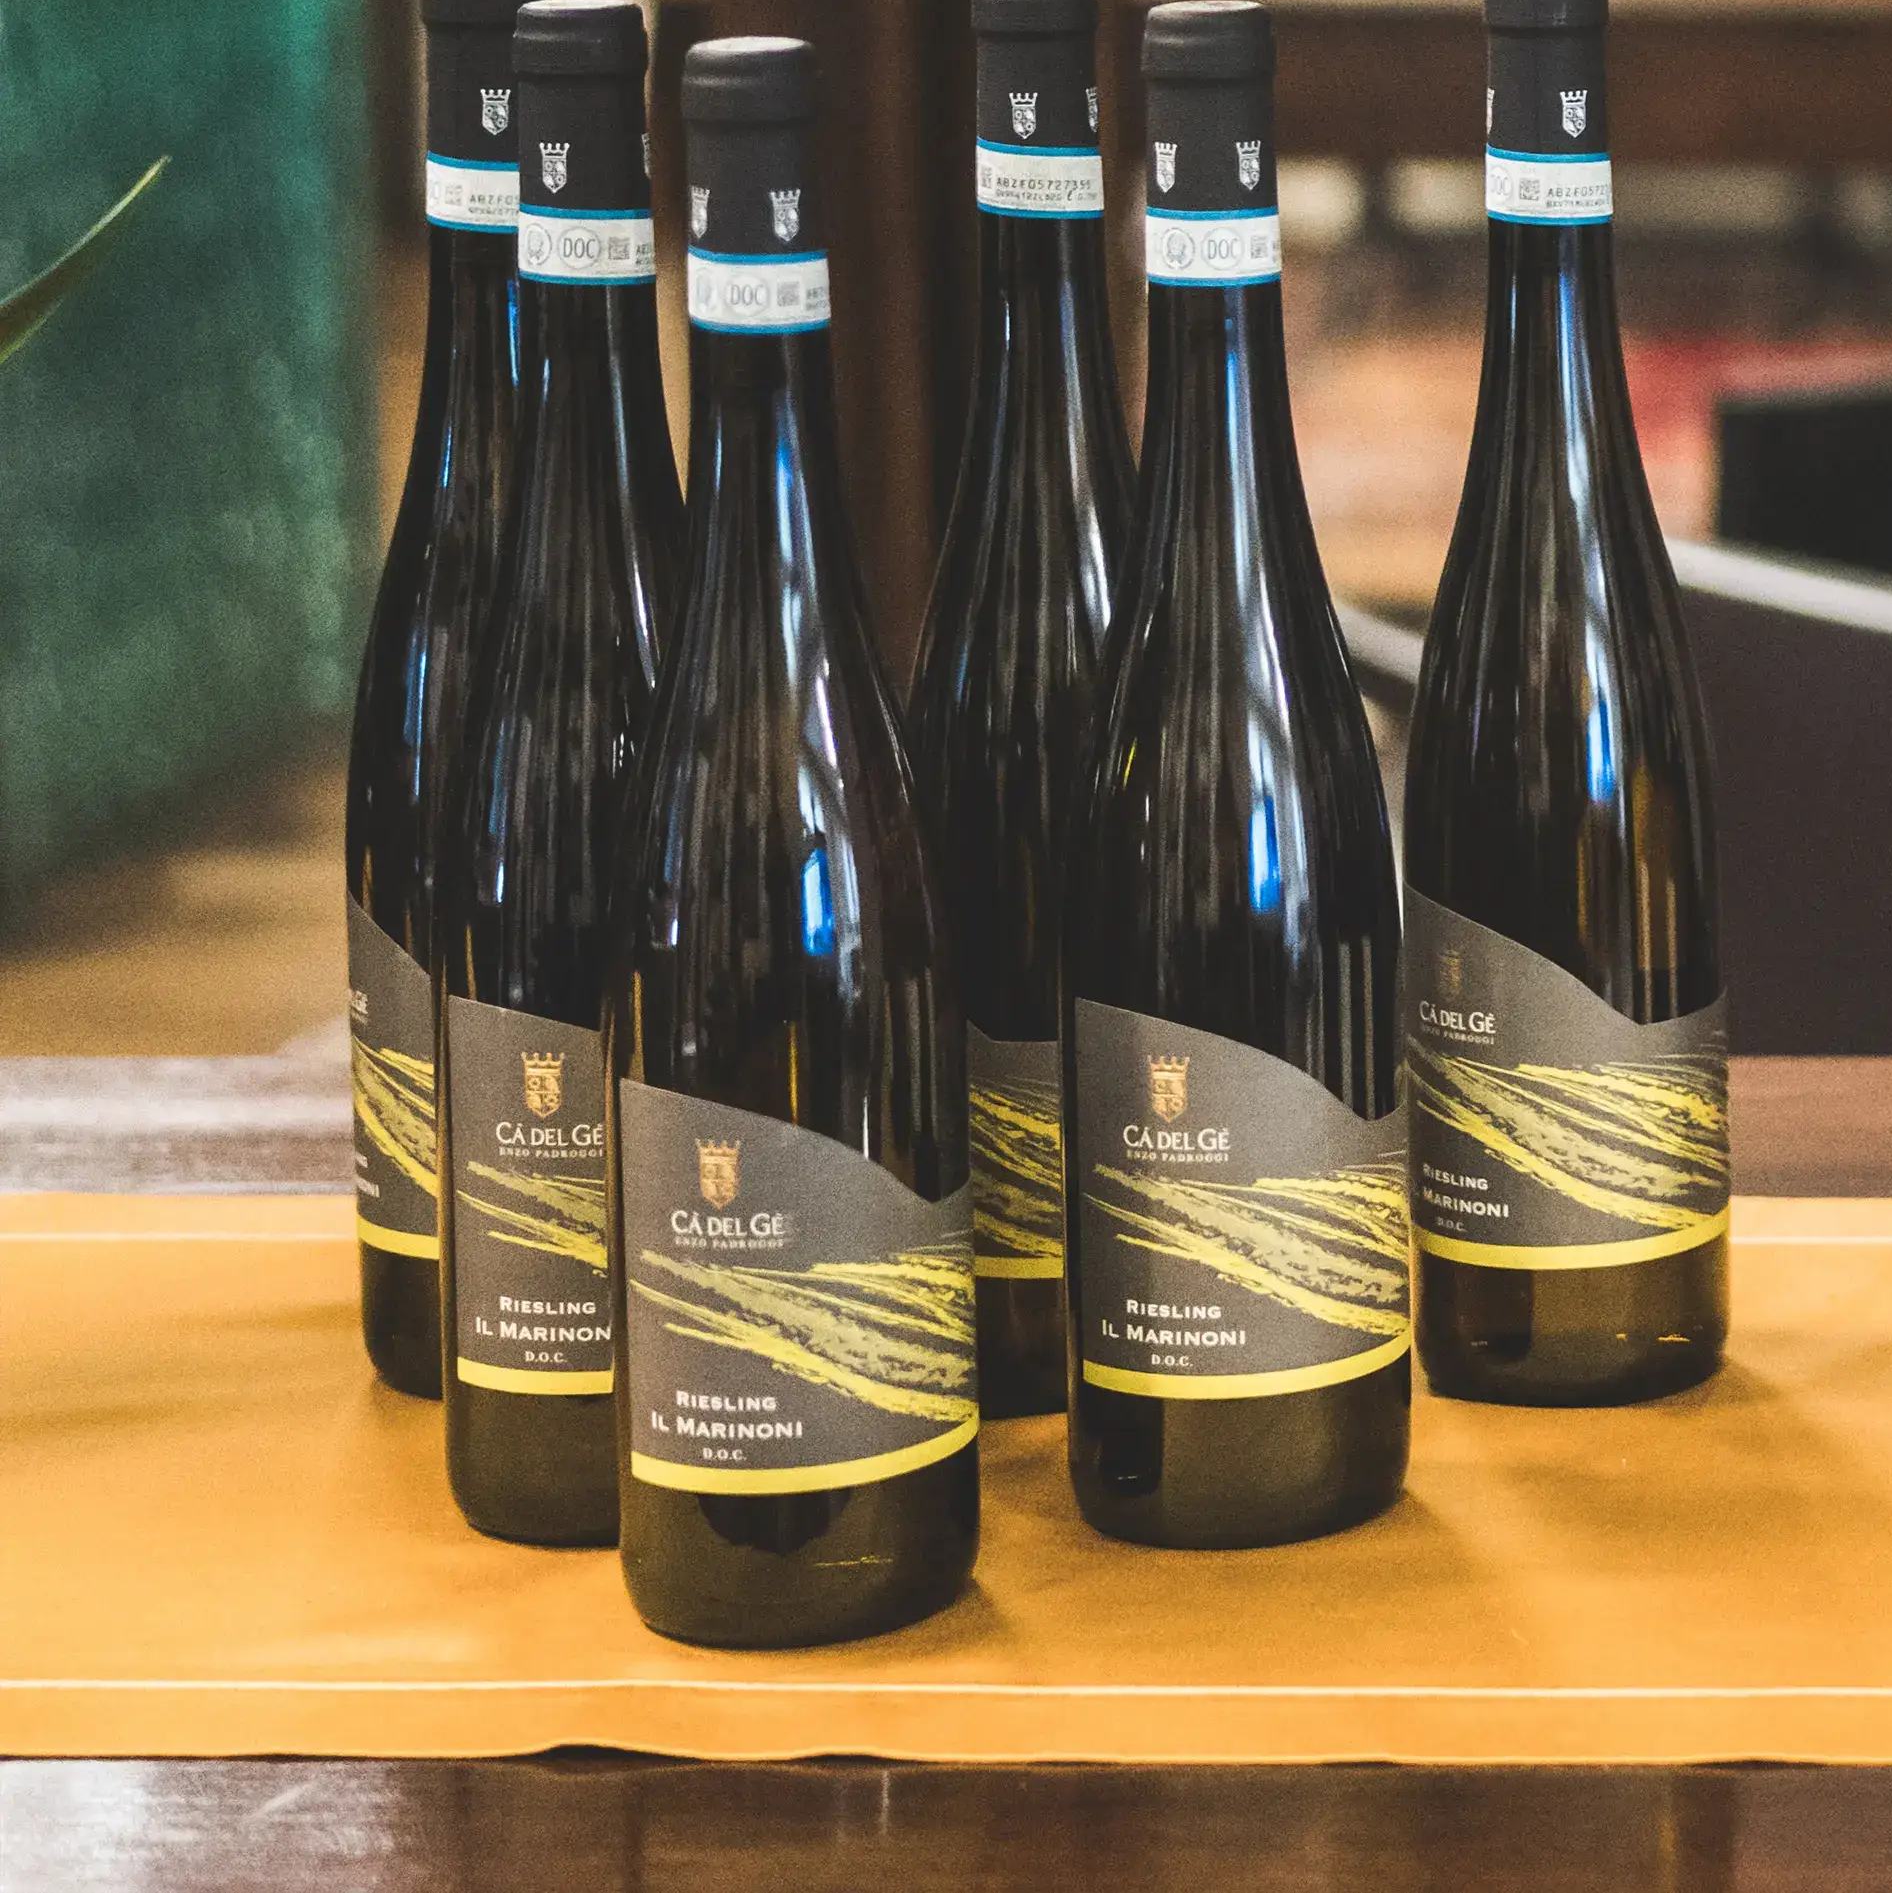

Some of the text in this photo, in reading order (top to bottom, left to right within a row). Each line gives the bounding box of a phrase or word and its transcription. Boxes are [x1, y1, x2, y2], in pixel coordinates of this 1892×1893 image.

[563, 238, 597, 258] DOC
[1208, 238, 1238, 259] DOC
[730, 284, 763, 306] DOC
[1440, 1010, 1466, 1030] DEL
[531, 1128, 569, 1146] DEL
[1157, 1131, 1195, 1150] DEL
[1423, 1162, 1488, 1191] RIESLING
[1422, 1187, 1509, 1218] MARINONI
[707, 1216, 748, 1237] DEL
[500, 1296, 596, 1315] RIESLING
[1127, 1299, 1221, 1319] RIESLING
[475, 1316, 494, 1336] IL
[1102, 1319, 1246, 1346] IL MARINONI
[676, 1390, 776, 1411] RIESLING
[651, 1410, 802, 1439] IL MARINONI
